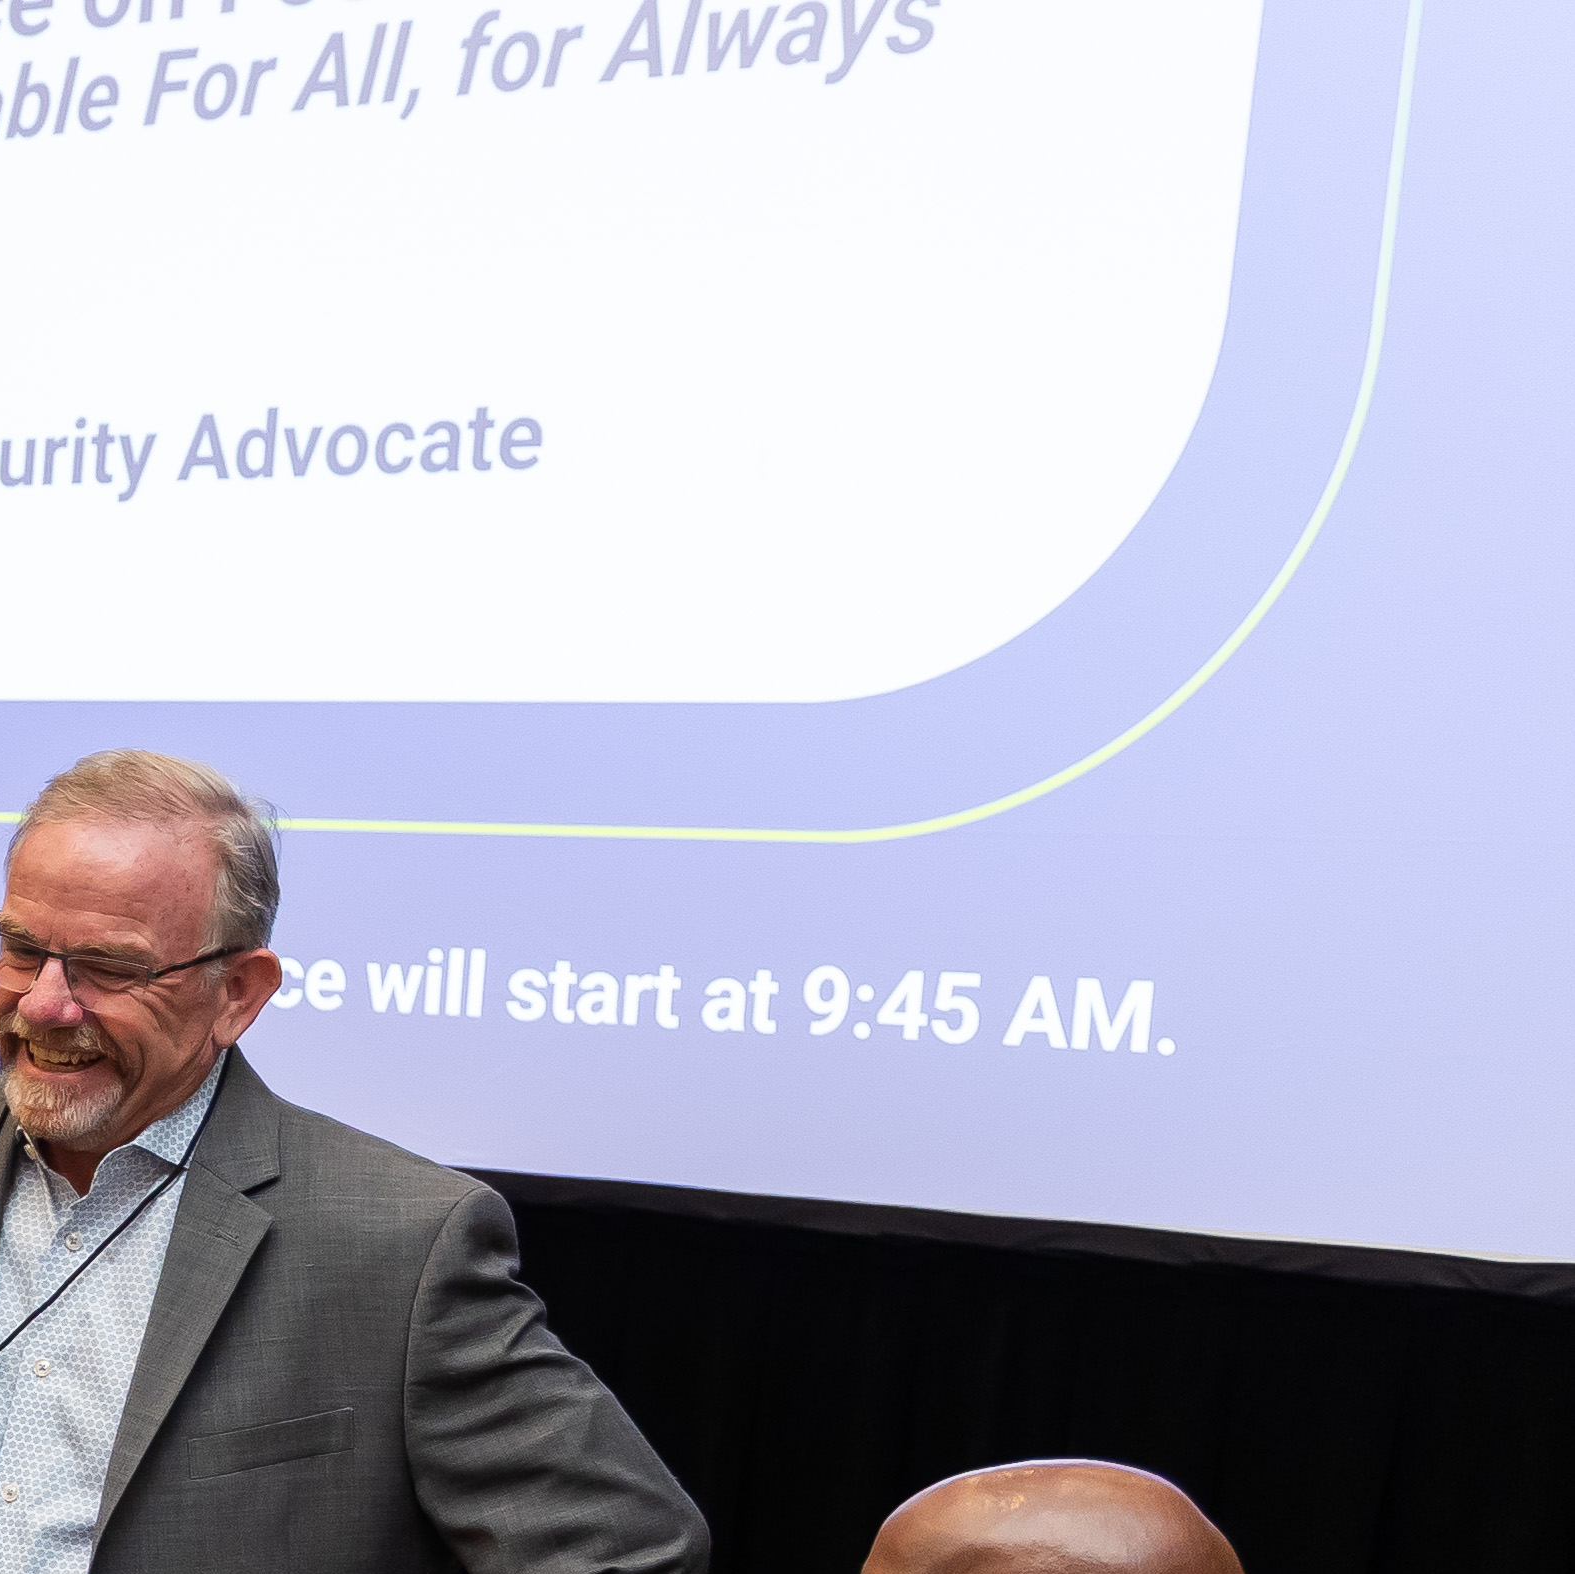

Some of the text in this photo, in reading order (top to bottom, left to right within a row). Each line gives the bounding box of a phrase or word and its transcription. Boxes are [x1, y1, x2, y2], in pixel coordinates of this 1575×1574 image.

[144, 48, 277, 126] For
[292, 20, 419, 119] All,
[457, 10, 583, 96] for
[599, 0, 941, 84] Always
[176, 406, 545, 482] Advocate
[366, 947, 486, 1017] will
[505, 960, 681, 1029] start
[701, 969, 779, 1034] at
[803, 965, 981, 1044] 9:45
[1002, 975, 1176, 1055] AM.
